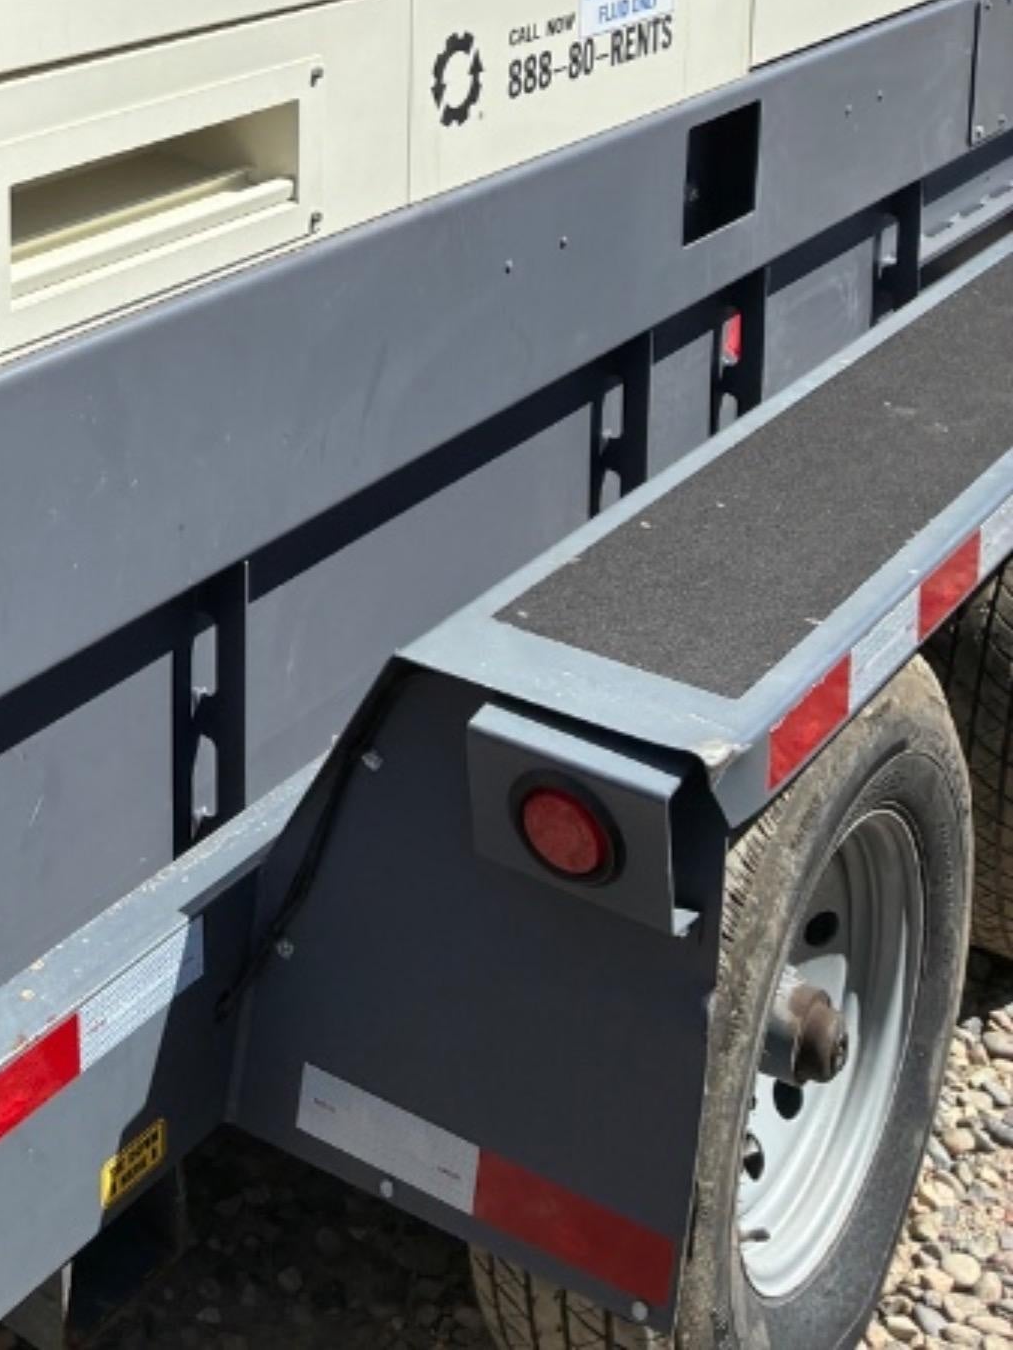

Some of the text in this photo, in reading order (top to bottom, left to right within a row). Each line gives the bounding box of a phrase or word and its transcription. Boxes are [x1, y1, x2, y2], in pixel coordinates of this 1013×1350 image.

[508, 12, 576, 46] CALL NOW
[508, 14, 673, 99] 888-80-RENTS
